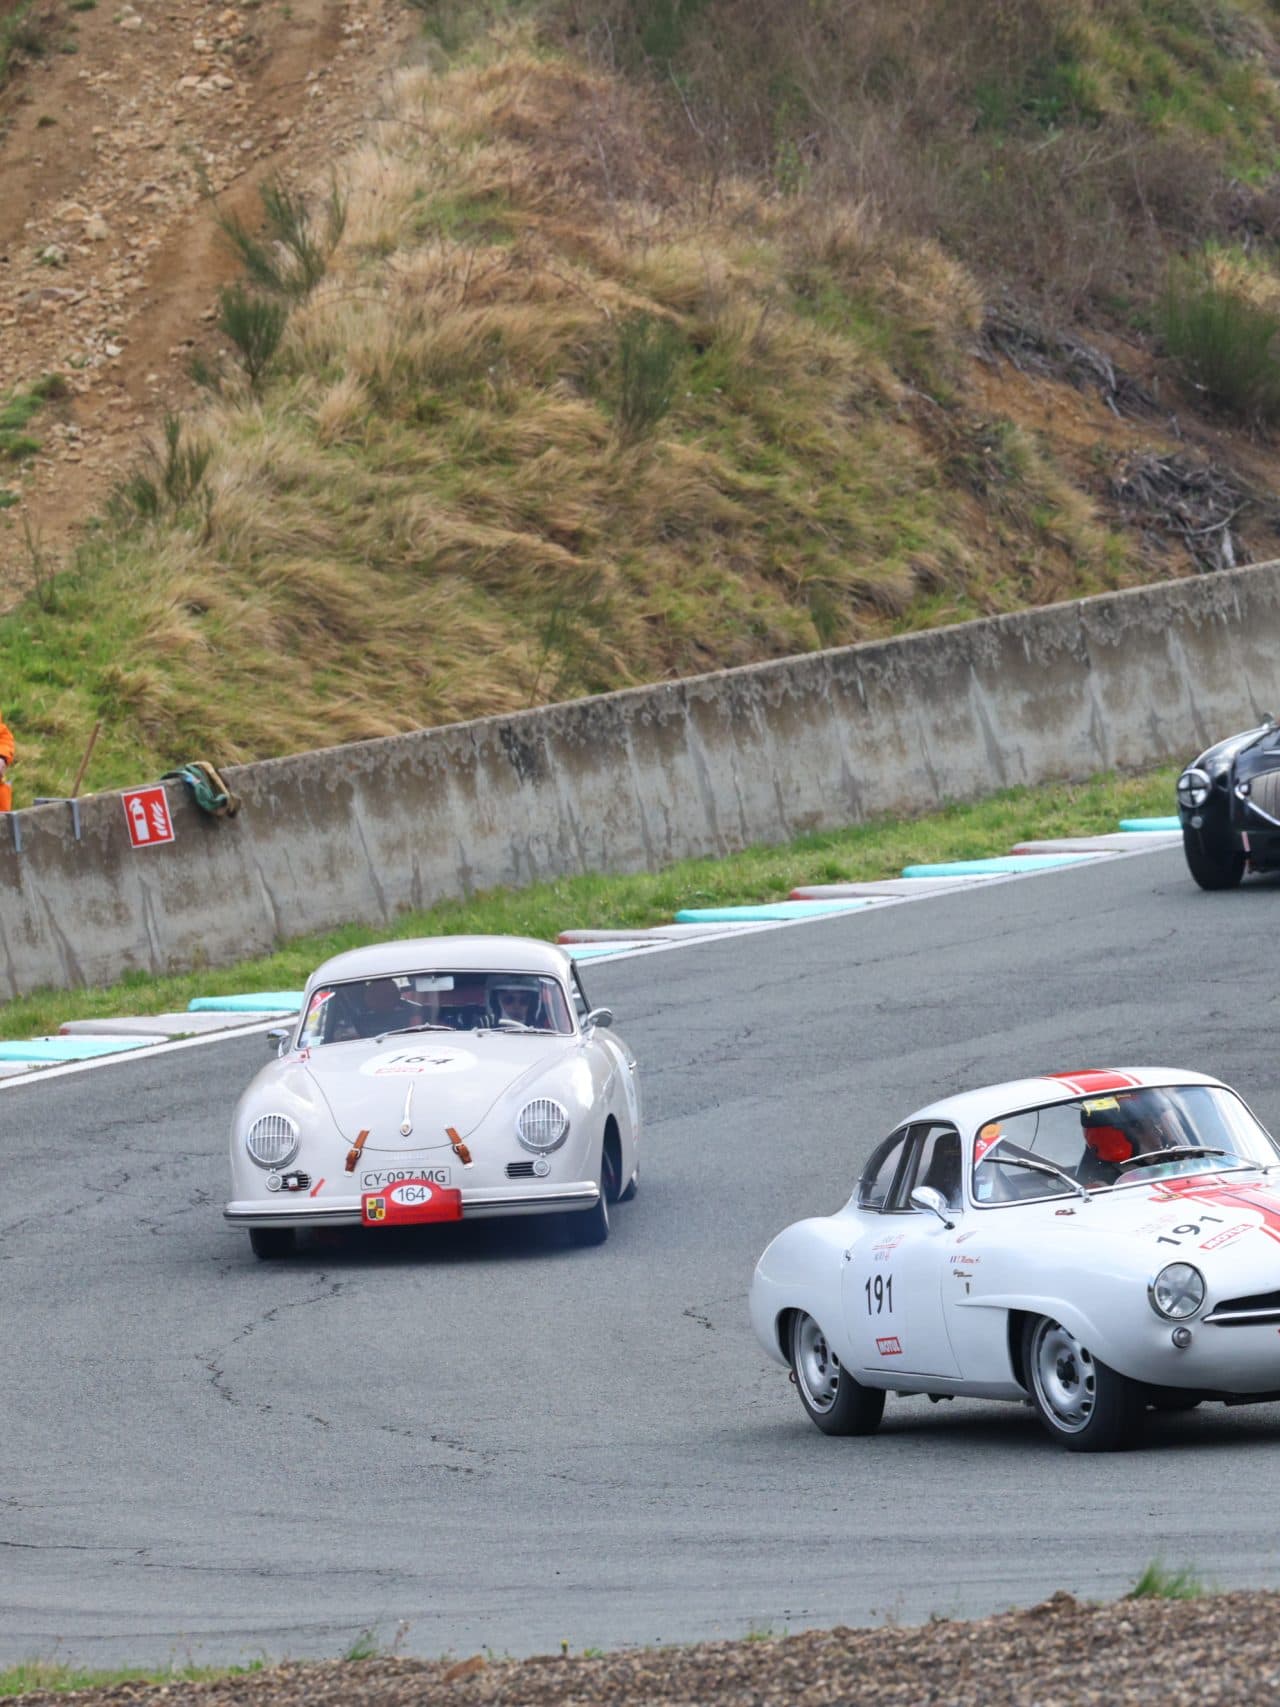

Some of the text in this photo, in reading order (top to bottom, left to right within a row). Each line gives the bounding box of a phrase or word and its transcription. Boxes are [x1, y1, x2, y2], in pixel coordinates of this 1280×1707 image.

[364, 1170, 447, 1187] CY-097-MG
[397, 1187, 427, 1203] 164
[1156, 1215, 1225, 1246] 191
[864, 1273, 893, 1316] 191
